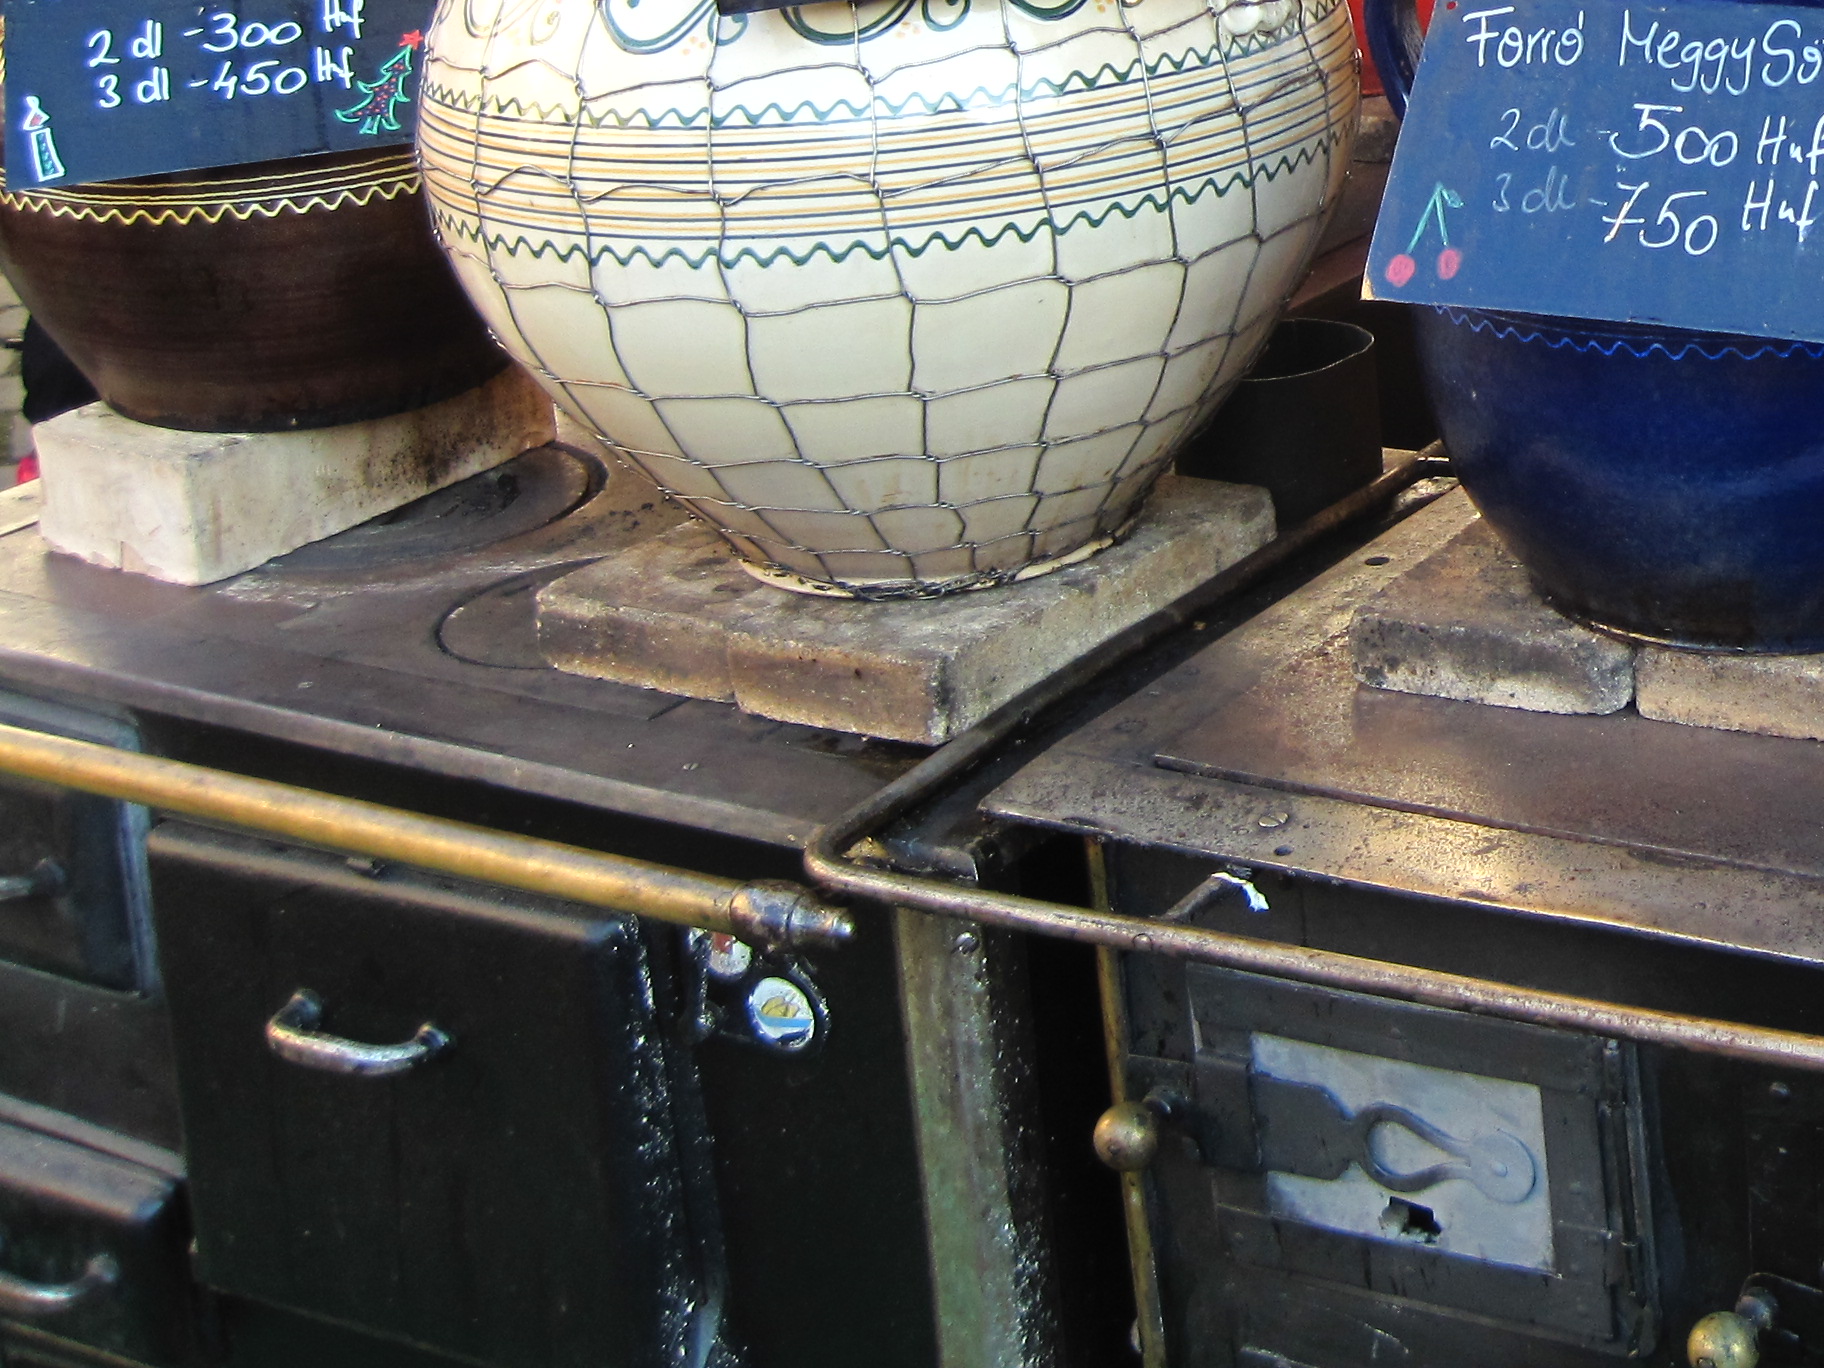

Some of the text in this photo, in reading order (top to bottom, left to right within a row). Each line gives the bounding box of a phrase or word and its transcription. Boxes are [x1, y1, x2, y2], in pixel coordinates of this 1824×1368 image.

[88, 30, 119, 68] 2
[132, 19, 162, 60] dl
[1462, 6, 1586, 67] Forró
[99, 74, 123, 109] 3
[137, 66, 170, 104] dl
[316, 46, 355, 89] Huf
[1490, 108, 1521, 150] 2
[1527, 113, 1575, 152] dl
[1493, 175, 1511, 212] 3
[1522, 172, 1575, 212] dl
[1741, 180, 1818, 243] Huf
